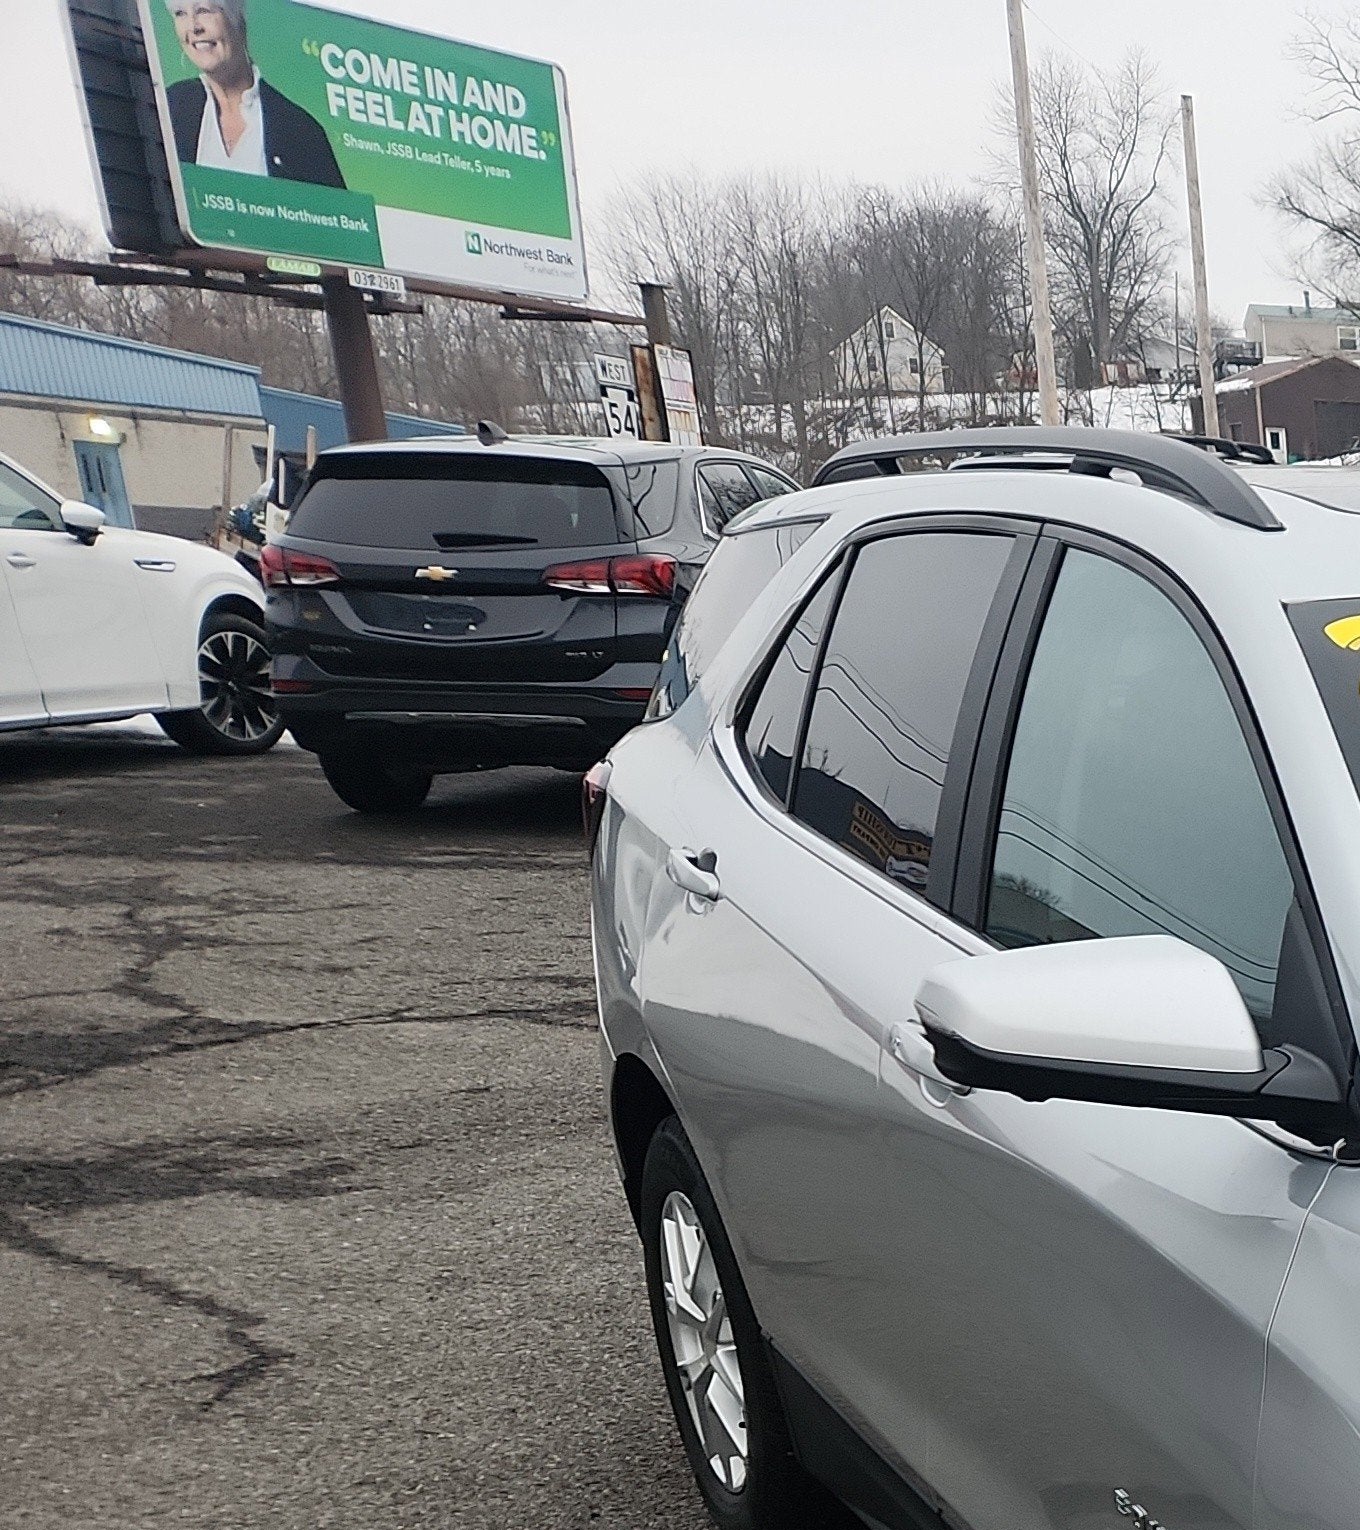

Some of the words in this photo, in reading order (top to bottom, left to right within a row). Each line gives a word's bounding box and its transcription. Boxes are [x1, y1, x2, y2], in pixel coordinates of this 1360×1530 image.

[326, 82, 405, 131] FEEL
[407, 101, 444, 138] AT
[424, 66, 459, 105] IN
[463, 77, 526, 118] AND
[343, 133, 384, 154] Shawn,
[386, 143, 413, 159] JSSB
[415, 147, 442, 165] Lead
[475, 159, 482, 173] 5
[483, 163, 511, 179] years
[202, 193, 235, 212] JSSB
[236, 198, 247, 214] is
[249, 205, 275, 218] now
[277, 205, 339, 228] Northwest
[340, 214, 369, 233] Bank
[483, 238, 543, 261] Northwest
[546, 249, 573, 265] Bank
[598, 358, 626, 381] WEST
[608, 401, 636, 437] 54
